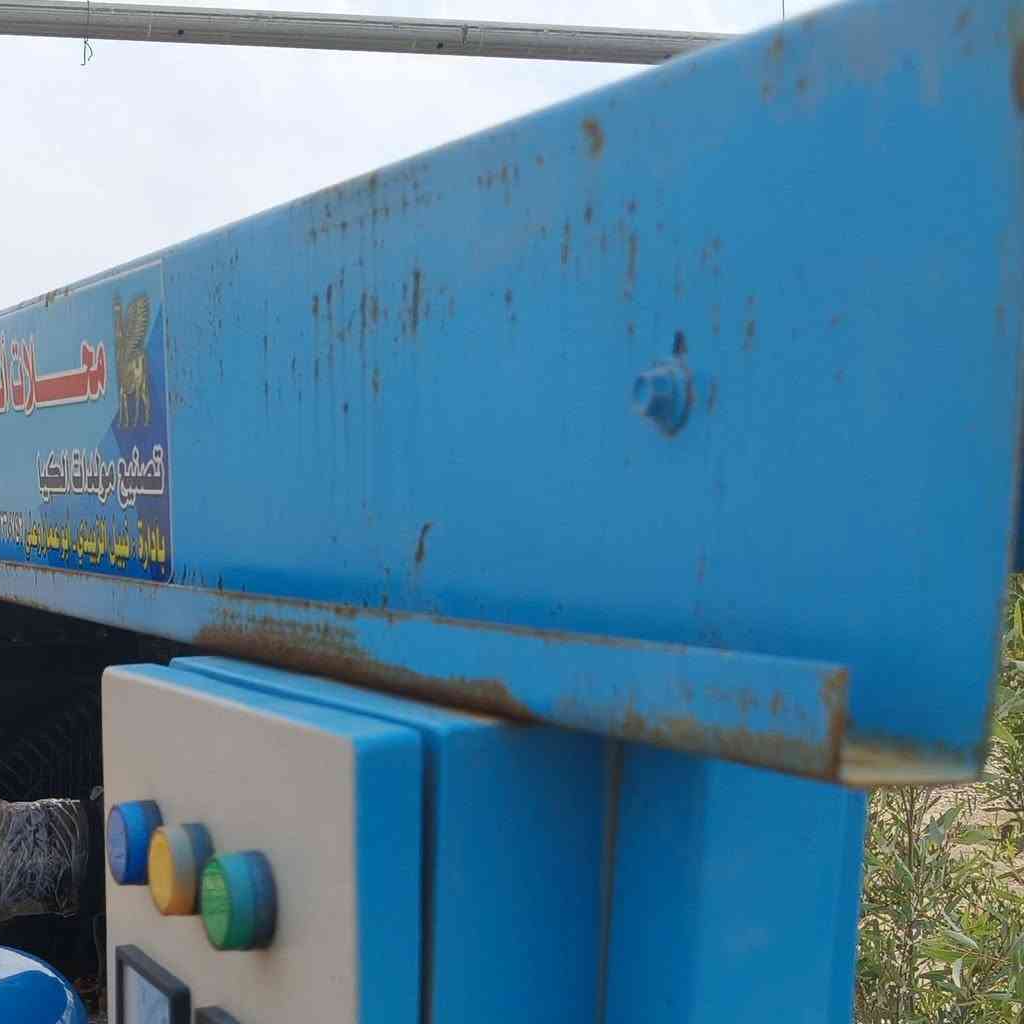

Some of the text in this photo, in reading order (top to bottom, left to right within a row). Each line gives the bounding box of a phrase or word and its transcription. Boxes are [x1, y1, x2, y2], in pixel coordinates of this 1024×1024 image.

[9, 334, 106, 415] محلات
[72, 448, 117, 503] مولدات
[117, 442, 165, 508] تصنيع
